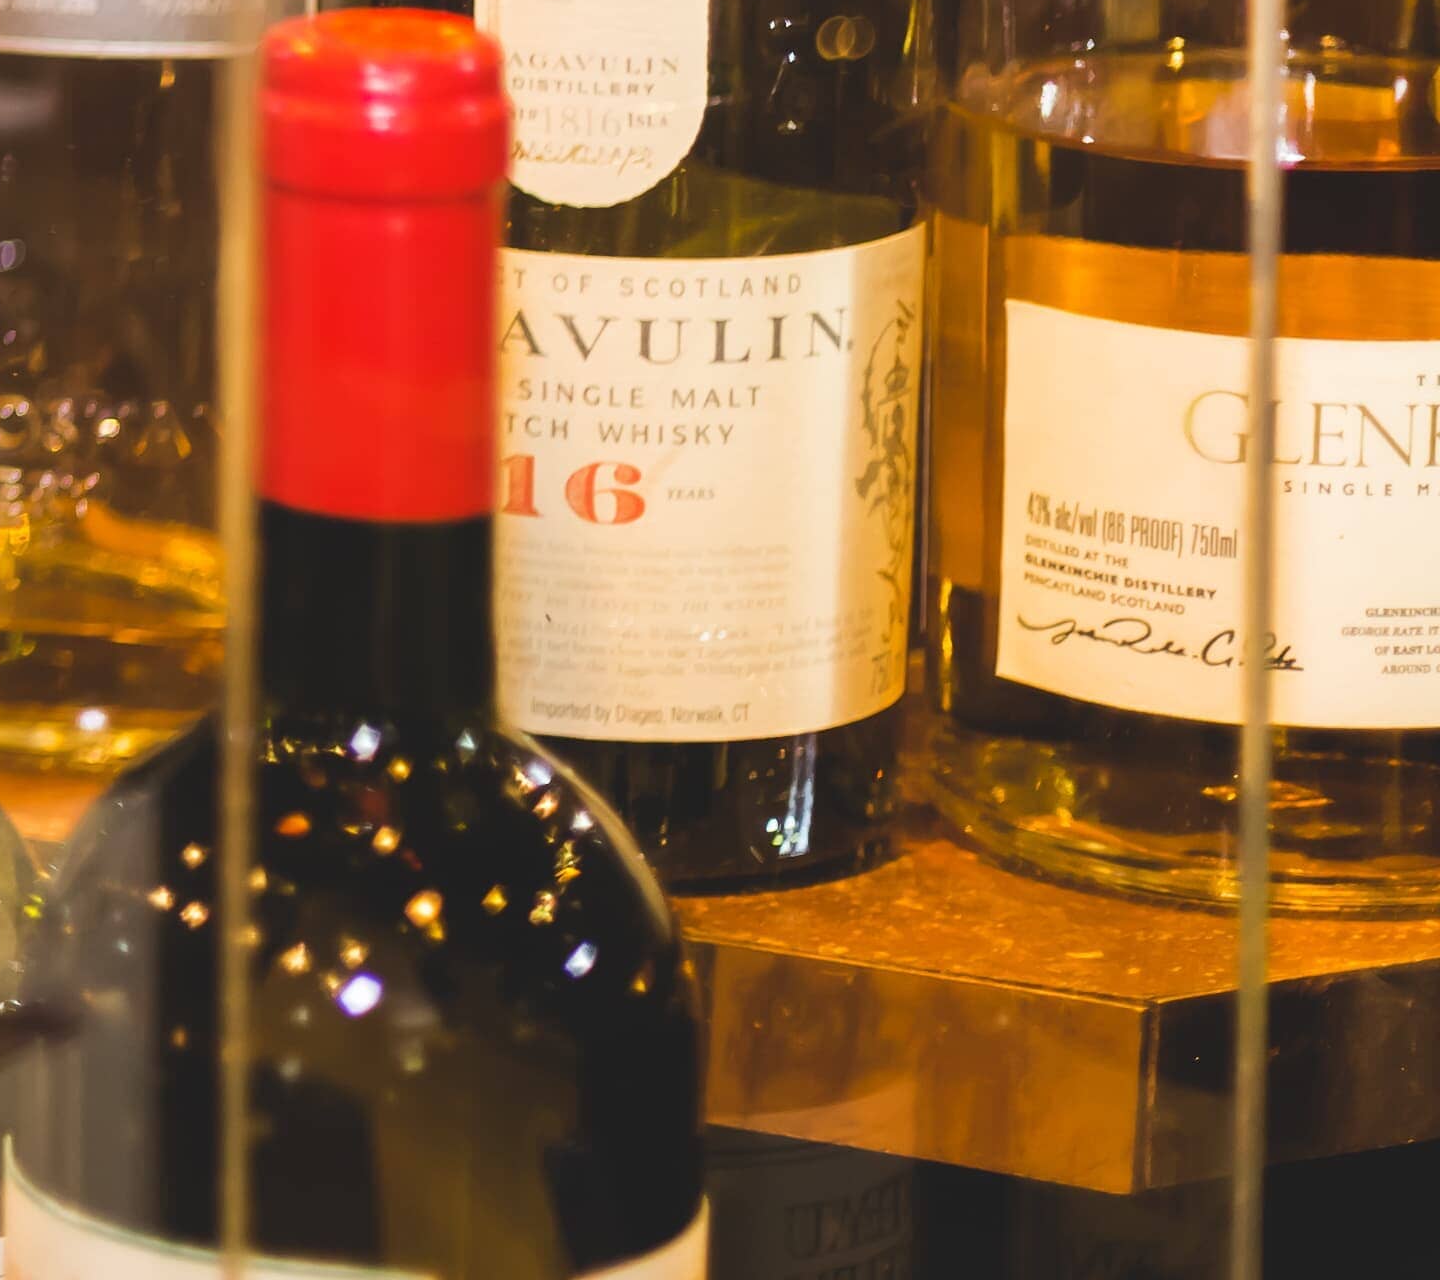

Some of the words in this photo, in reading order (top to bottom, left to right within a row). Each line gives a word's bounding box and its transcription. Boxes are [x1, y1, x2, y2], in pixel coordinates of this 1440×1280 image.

[509, 51, 680, 75] AGAVULIN
[512, 76, 656, 97] DISTILLERY
[552, 272, 593, 295] OF
[619, 272, 803, 299] SCOTLAND
[500, 306, 855, 366] AVULIN.
[517, 379, 645, 409] SINGLE
[672, 385, 762, 410] MALT
[598, 422, 736, 447] WHISKY
[500, 453, 647, 526] 16
[1283, 480, 1393, 497] SINGLE
[1191, 522, 1239, 559] 750ml
[1084, 550, 1100, 562] AT
[1104, 554, 1129, 569] THE
[1025, 553, 1118, 586] GLENKINCHIE
[1123, 577, 1218, 601] DISTILLERY
[1110, 593, 1186, 616] SCOTLAND
[1365, 607, 1440, 618] GLENKINCH
[1392, 644, 1424, 656] EAST
[532, 696, 592, 722] Imported
[732, 703, 750, 722] CT
